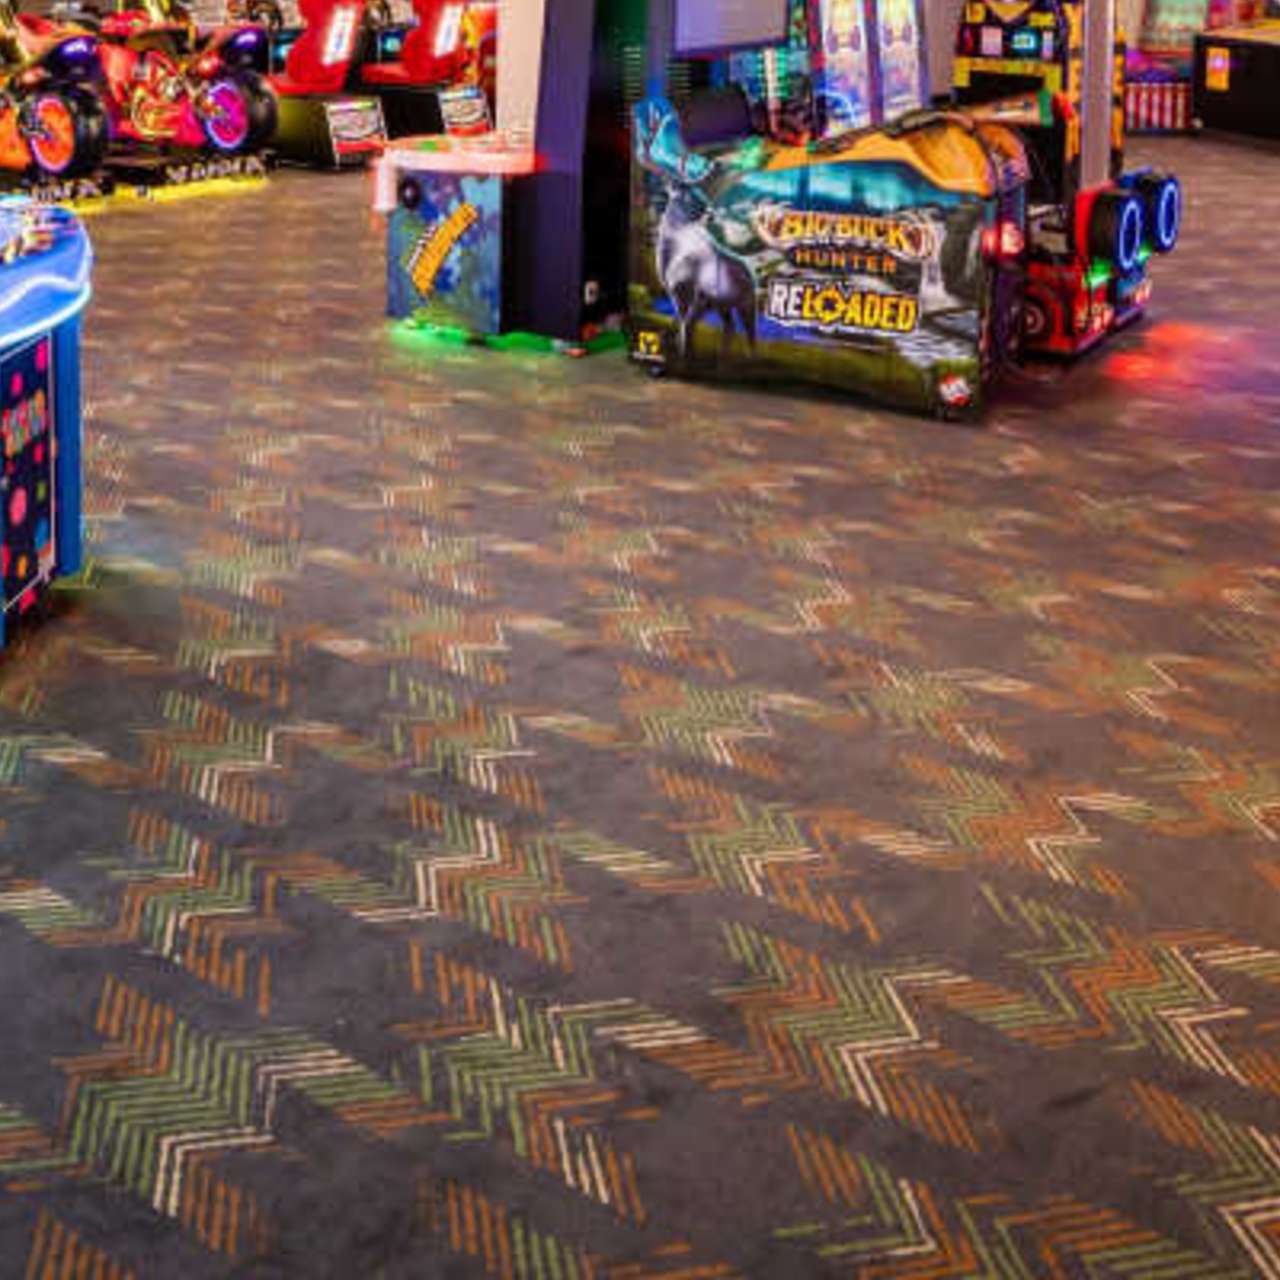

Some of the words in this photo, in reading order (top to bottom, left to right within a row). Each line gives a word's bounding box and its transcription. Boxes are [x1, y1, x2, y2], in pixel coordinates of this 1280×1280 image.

[780, 212, 833, 242] BIG
[835, 215, 919, 257] BUCK
[794, 247, 897, 275] HUNTER
[770, 281, 918, 333] RELOADED
